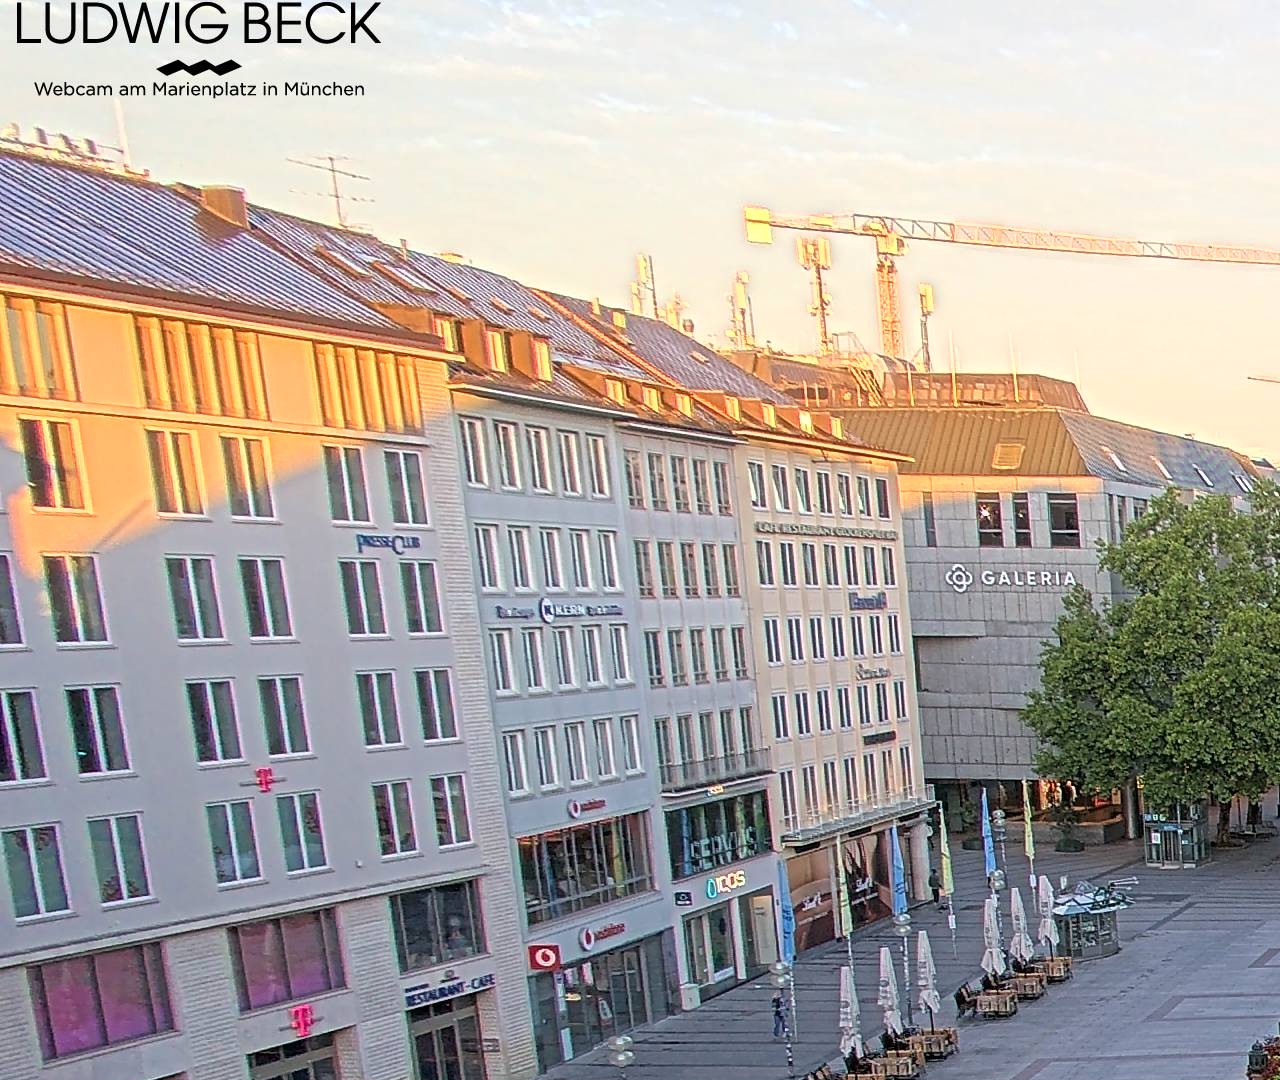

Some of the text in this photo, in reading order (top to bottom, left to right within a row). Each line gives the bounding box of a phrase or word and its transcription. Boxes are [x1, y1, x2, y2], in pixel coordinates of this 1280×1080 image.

[981, 570, 1077, 586] GALERIA
[715, 869, 746, 893] IQOS
[290, 1003, 314, 1037] T
